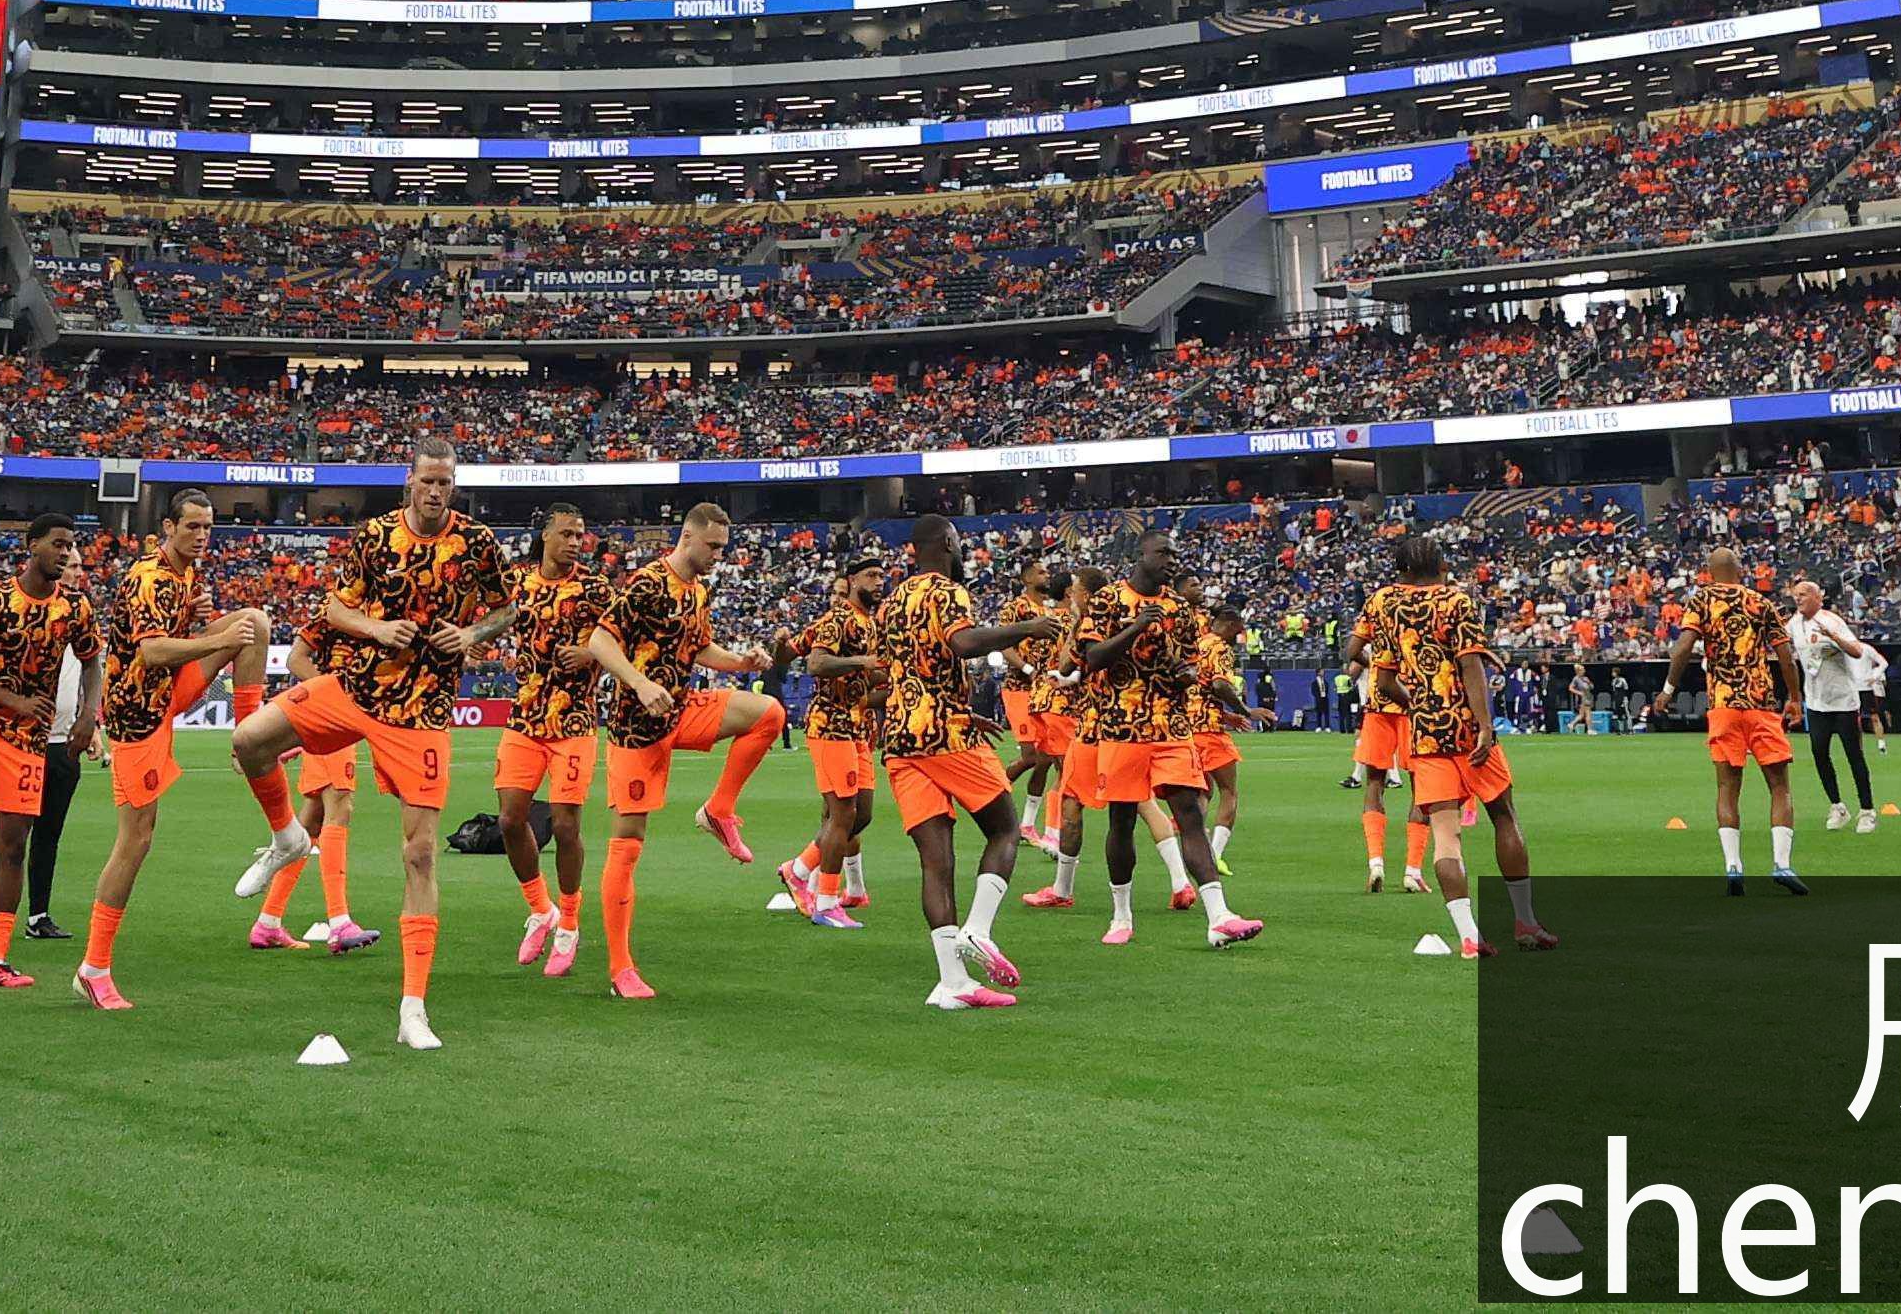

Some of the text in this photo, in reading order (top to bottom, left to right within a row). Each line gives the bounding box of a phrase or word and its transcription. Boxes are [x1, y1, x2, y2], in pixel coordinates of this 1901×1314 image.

[406, 3, 466, 19] FOOTBALL
[674, 0, 735, 16] FOOTBALL
[1648, 25, 1703, 49] FOOTBALL
[1414, 62, 1467, 84] FOOTBALL
[1197, 94, 1245, 112] FOOTBALL
[986, 116, 1035, 136] FOOTBALL
[94, 127, 147, 146] FOOTBALL
[324, 138, 373, 153] FOOTBALL
[771, 134, 818, 150] FOOTBALL
[549, 140, 599, 158] FOOTBALL
[1322, 168, 1377, 190] FOOTBALL
[35, 257, 102, 273] DALLAS
[534, 270, 568, 285] FIFA
[570, 270, 626, 285] WORLD
[1526, 414, 1590, 432] FOOTBALL
[1250, 432, 1310, 452] FOOTBALL
[1000, 448, 1053, 465] FOOTBALL
[226, 466, 289, 482] FOOTBALL
[500, 468, 556, 482] FOOTBALL
[761, 462, 816, 479] FOOTBALL
[422, 749, 438, 780] 9
[566, 755, 580, 783] 5
